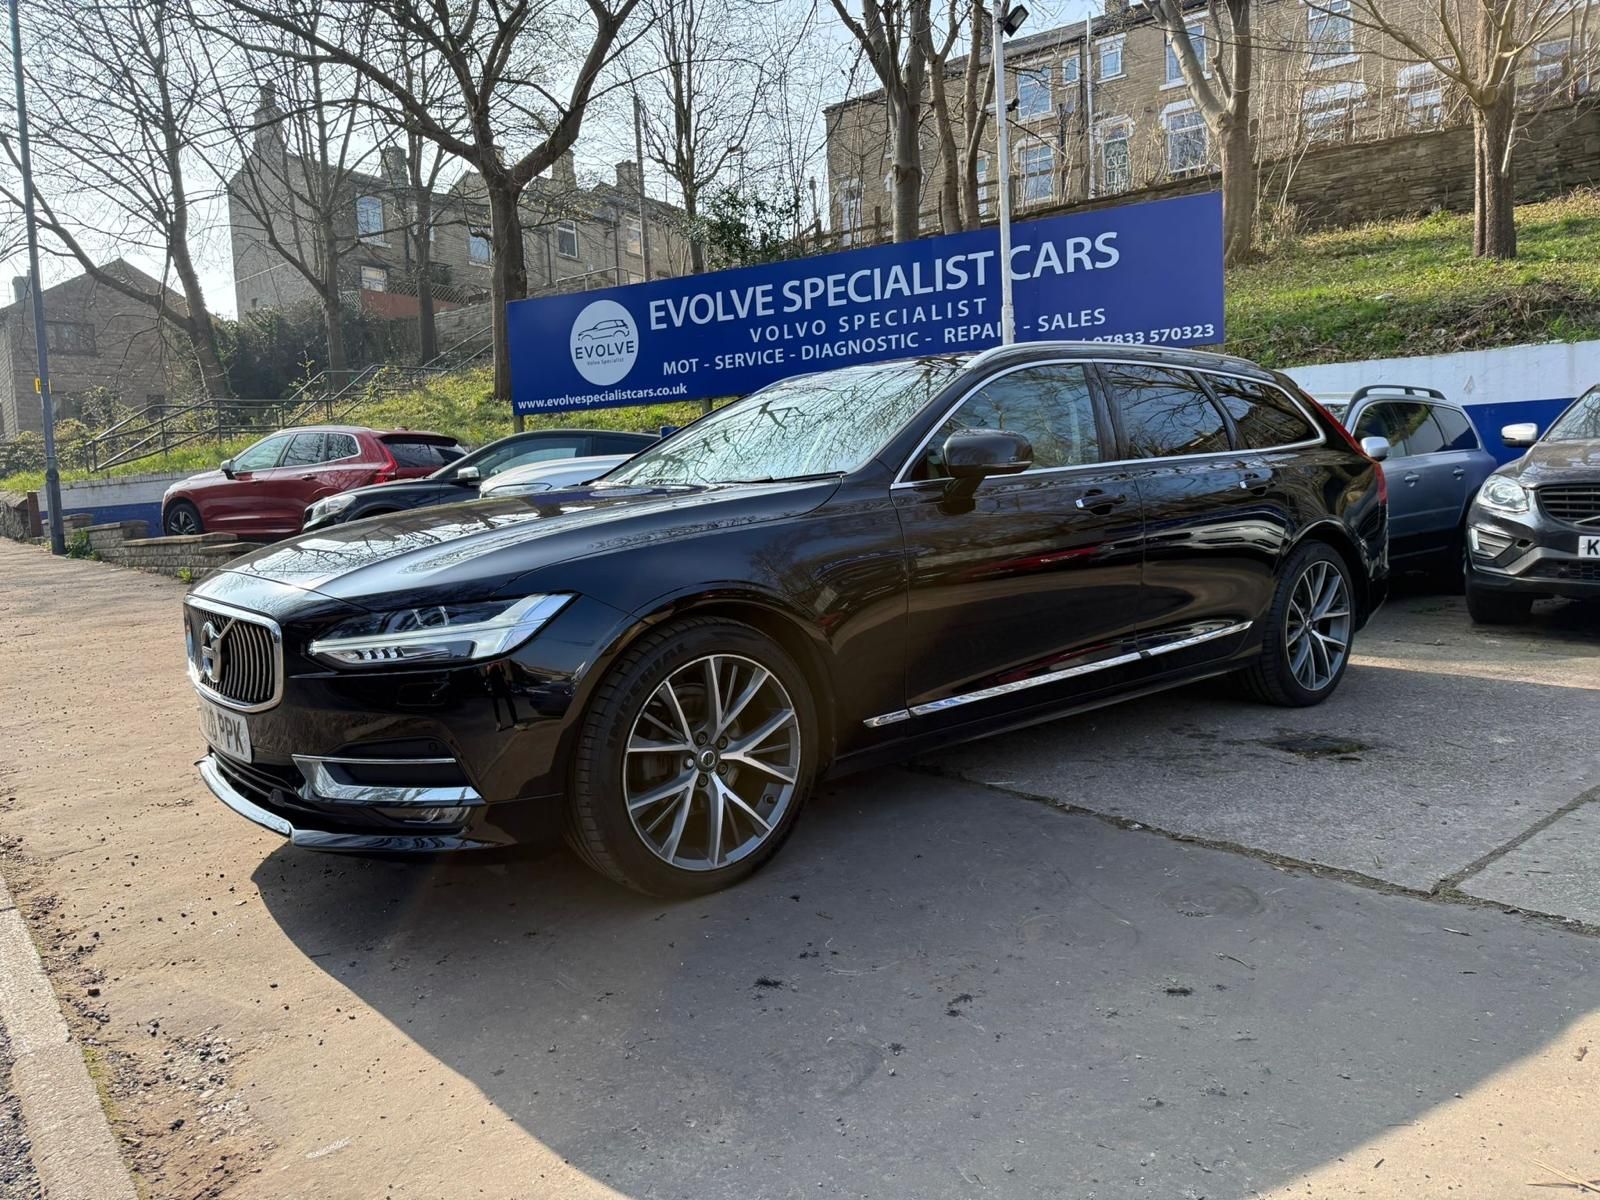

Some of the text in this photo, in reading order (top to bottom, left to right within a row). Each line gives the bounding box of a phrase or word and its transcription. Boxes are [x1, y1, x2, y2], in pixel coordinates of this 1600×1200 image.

[649, 231, 1120, 330] EVOLVE SPECIALIST CARS
[750, 297, 987, 343] VOLVO SPECIALIST
[1149, 323, 1215, 343] 570323
[575, 340, 635, 360] EVOLVE
[663, 357, 699, 376] MOT
[714, 348, 785, 370] SERVICE
[801, 331, 919, 361] DIAGNOSTIC
[944, 320, 1016, 344] REPAI
[1037, 307, 1106, 332] SALES
[518, 383, 687, 410] www.evolvespecialistcars.co.uk
